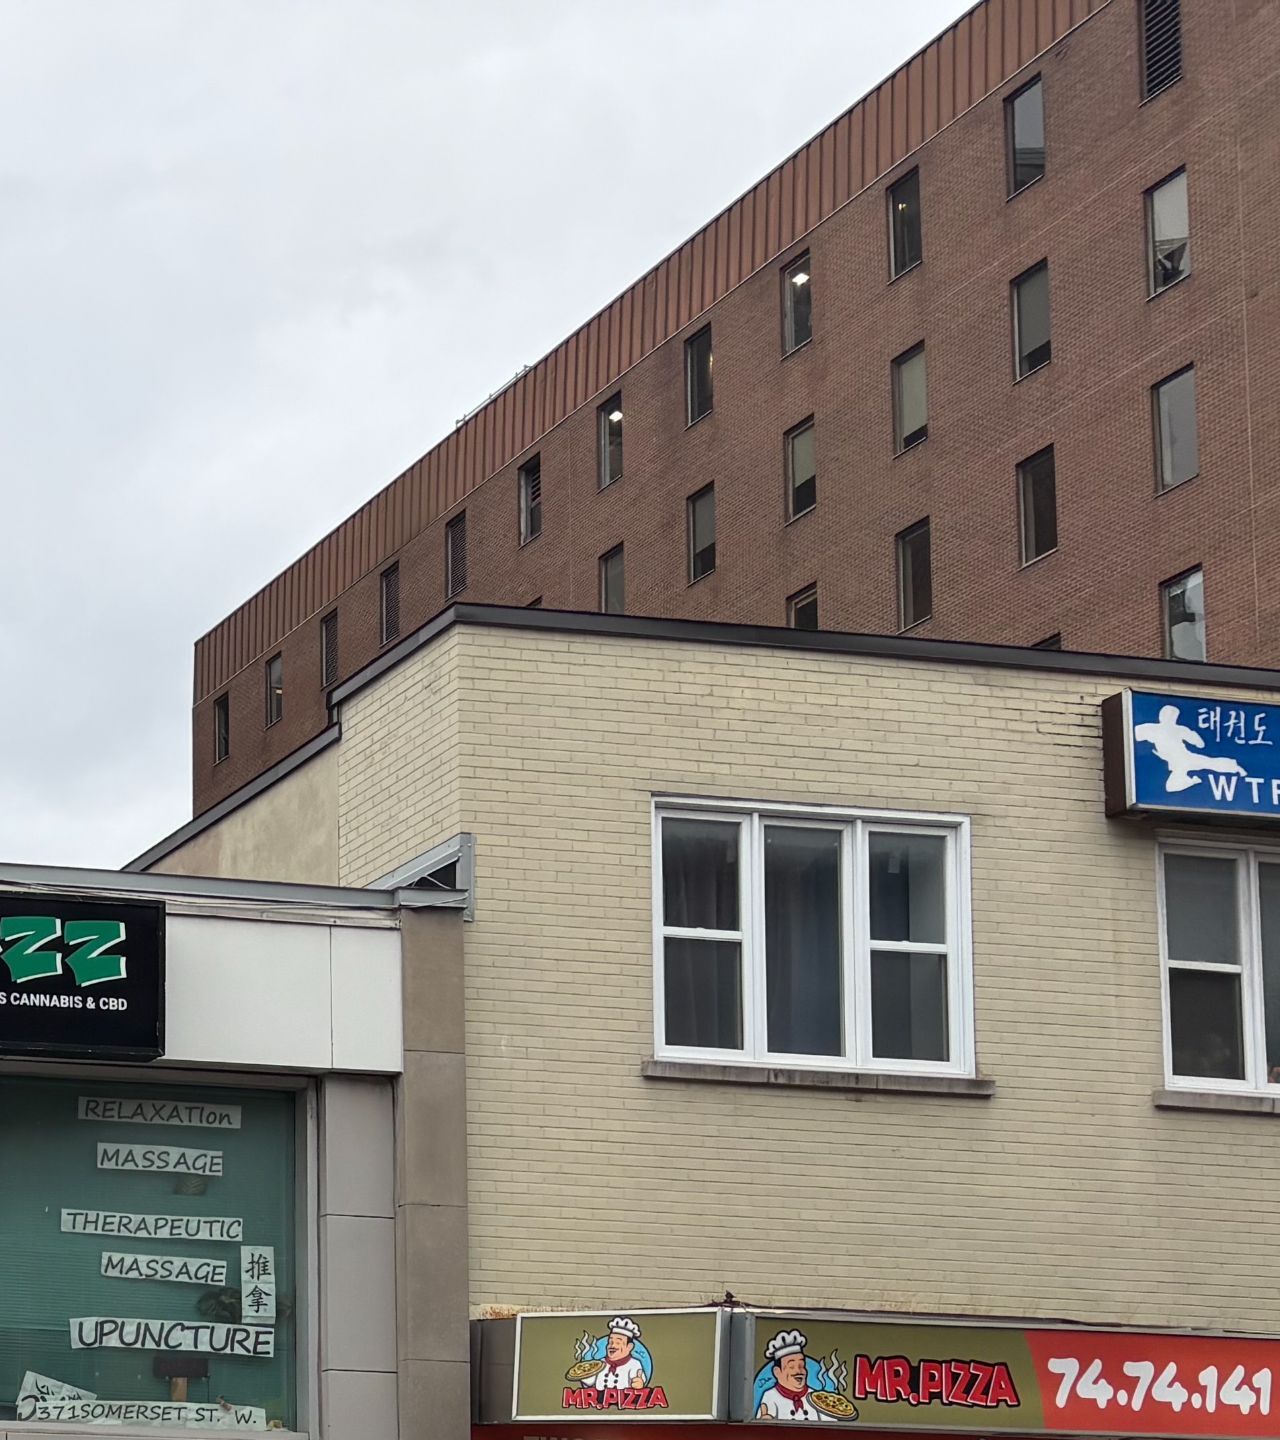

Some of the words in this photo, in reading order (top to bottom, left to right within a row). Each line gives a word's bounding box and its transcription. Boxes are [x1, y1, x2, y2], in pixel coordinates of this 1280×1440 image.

[1197, 706, 1274, 745] 태권도
[1207, 773, 1280, 806] WT
[10, 991, 83, 1010] CANNABIS
[86, 996, 96, 1010] &
[99, 997, 128, 1011] CBD
[100, 1149, 222, 1174] MASSAGE
[66, 1212, 242, 1239] THERAPEUTIC
[104, 1255, 226, 1283] MASSAGE
[77, 1319, 274, 1356] UPUNCTURE
[1047, 1357, 1273, 1416] 74.74.141
[194, 1408, 221, 1423] ST.
[234, 1410, 257, 1425] W.
